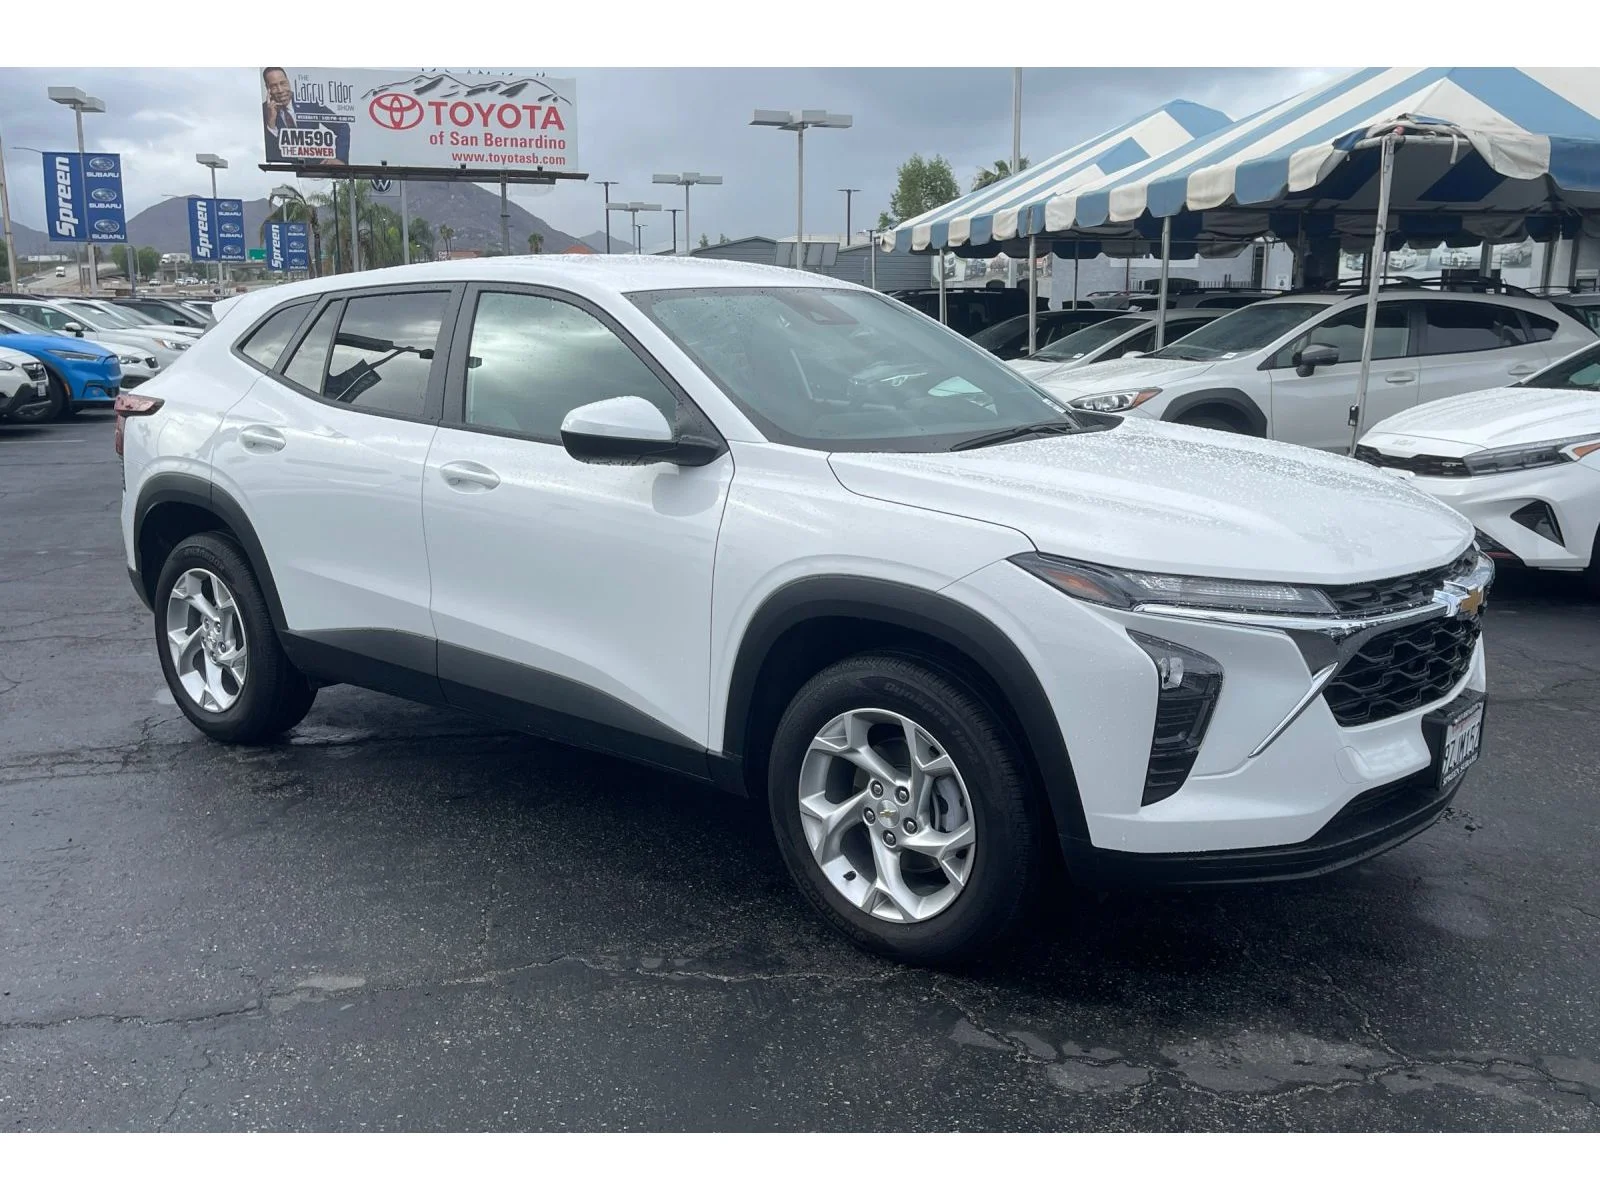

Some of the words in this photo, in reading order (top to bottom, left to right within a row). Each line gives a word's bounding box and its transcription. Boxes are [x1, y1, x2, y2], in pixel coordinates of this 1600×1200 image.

[294, 79, 324, 105] Larry
[328, 80, 354, 104] Elder
[428, 101, 565, 131] TOYOTA
[281, 129, 334, 147] AM590
[430, 131, 444, 145] of
[450, 131, 478, 146] San
[484, 132, 566, 150] Bernardino
[281, 146, 297, 156] THE
[297, 147, 335, 157] ANSWER
[452, 152, 566, 166] www.toyotasb.com
[55, 156, 79, 238] Spreen
[196, 200, 213, 258] Spreen
[271, 224, 284, 269] Spreen
